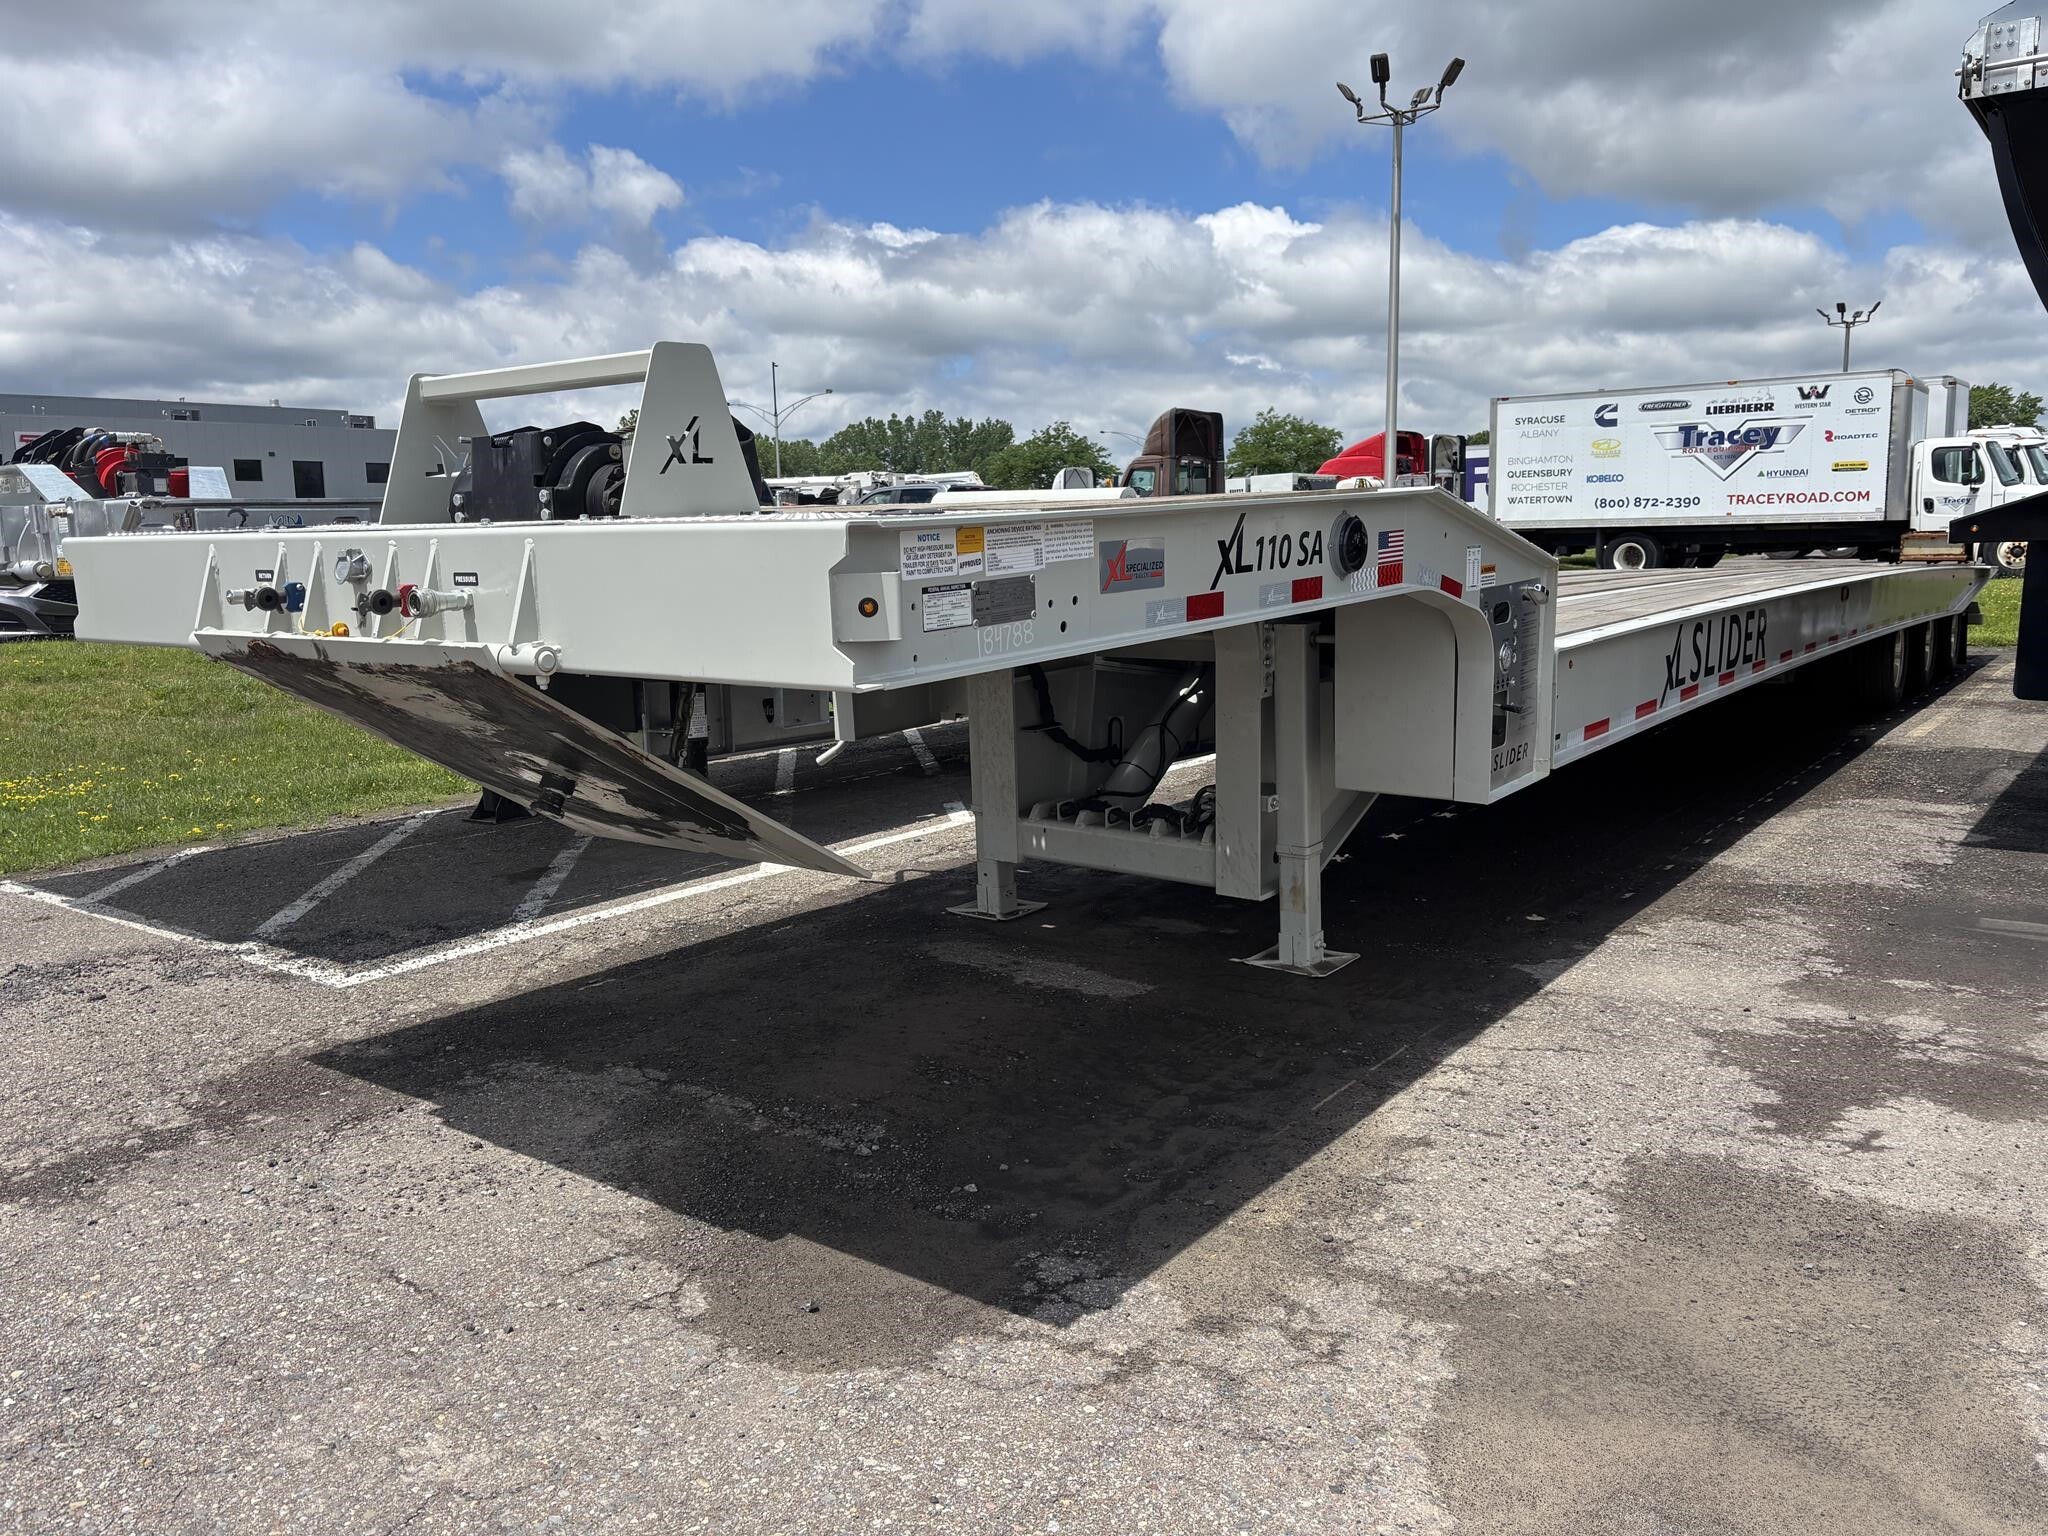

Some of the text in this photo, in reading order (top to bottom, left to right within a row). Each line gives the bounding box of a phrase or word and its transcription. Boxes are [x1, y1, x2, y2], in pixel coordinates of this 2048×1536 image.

[1642, 402, 1687, 410] FREIGHTLINER
[1705, 402, 1775, 415] LIEBHERR
[1514, 415, 1567, 426] SYRACUSE
[1520, 429, 1560, 439] ALBANY
[1678, 425, 1782, 450] Tracey
[1834, 433, 1878, 441] ROADTEC
[659, 416, 714, 475] XL
[1507, 455, 1574, 466] BINGHAMTON
[1507, 468, 1573, 479] QUEENSBURY
[1766, 468, 1809, 477] HYUNDAI
[1586, 474, 1624, 483] KOBELCO
[1511, 482, 1568, 492] ROCHESTER
[1507, 495, 1573, 505] WATERTOWN
[1594, 496, 1701, 509] (800) 872-2390
[1727, 490, 1871, 505] TRACEYROAD.COM
[1943, 497, 1971, 505] Tracey
[917, 533, 941, 542] NOTICE
[1210, 512, 1323, 591] XL 110 SA
[960, 558, 982, 568] APPROVED
[1102, 539, 1132, 592] XL
[1126, 561, 1164, 572] SPECIALIZED
[455, 575, 476, 583] PRESSURE
[1689, 607, 1768, 683] SLIDER
[1493, 741, 1529, 773] SLIDER
